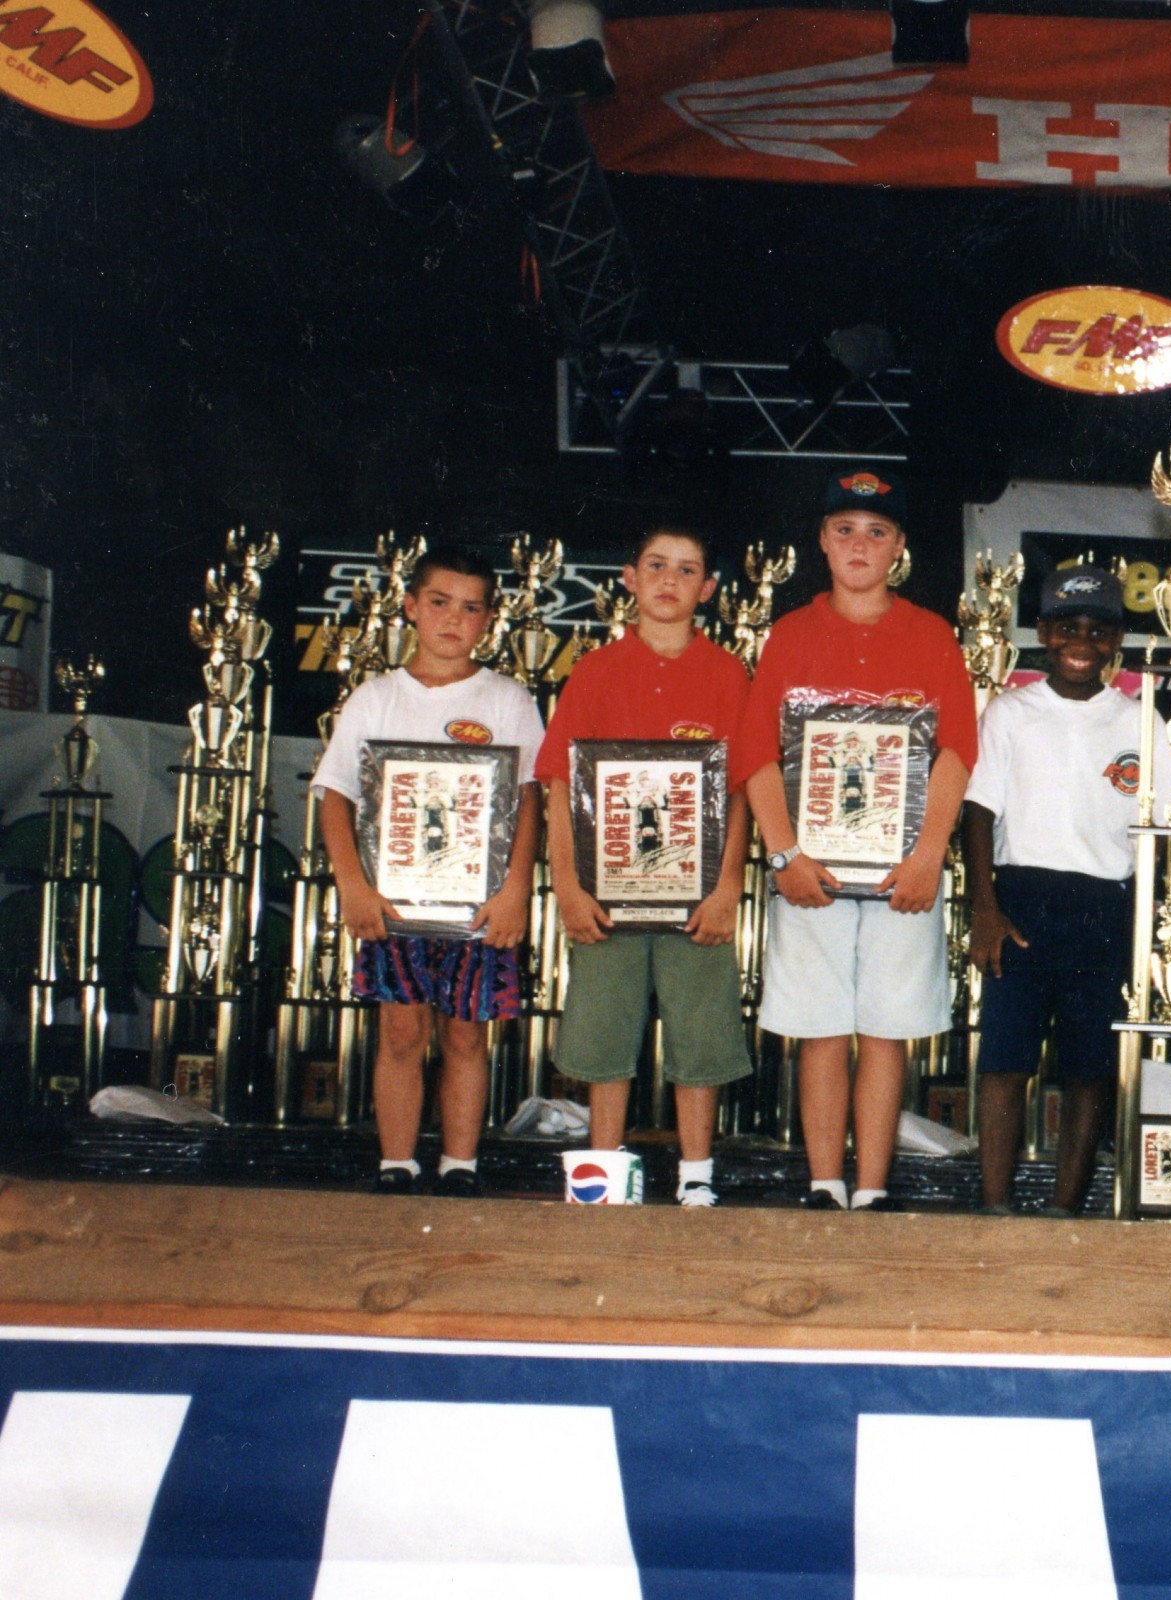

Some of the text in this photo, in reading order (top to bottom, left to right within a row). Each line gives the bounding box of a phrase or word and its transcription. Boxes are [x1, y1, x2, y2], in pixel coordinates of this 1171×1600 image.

[448, 723, 491, 742] FMF
[673, 727, 712, 739] FMF
[669, 771, 696, 846] LYNN'S
[806, 732, 840, 828] LORETTA
[388, 772, 419, 868] LORETTA
[604, 772, 631, 868] LORETTA
[1144, 1132, 1159, 1181] LORETTA
